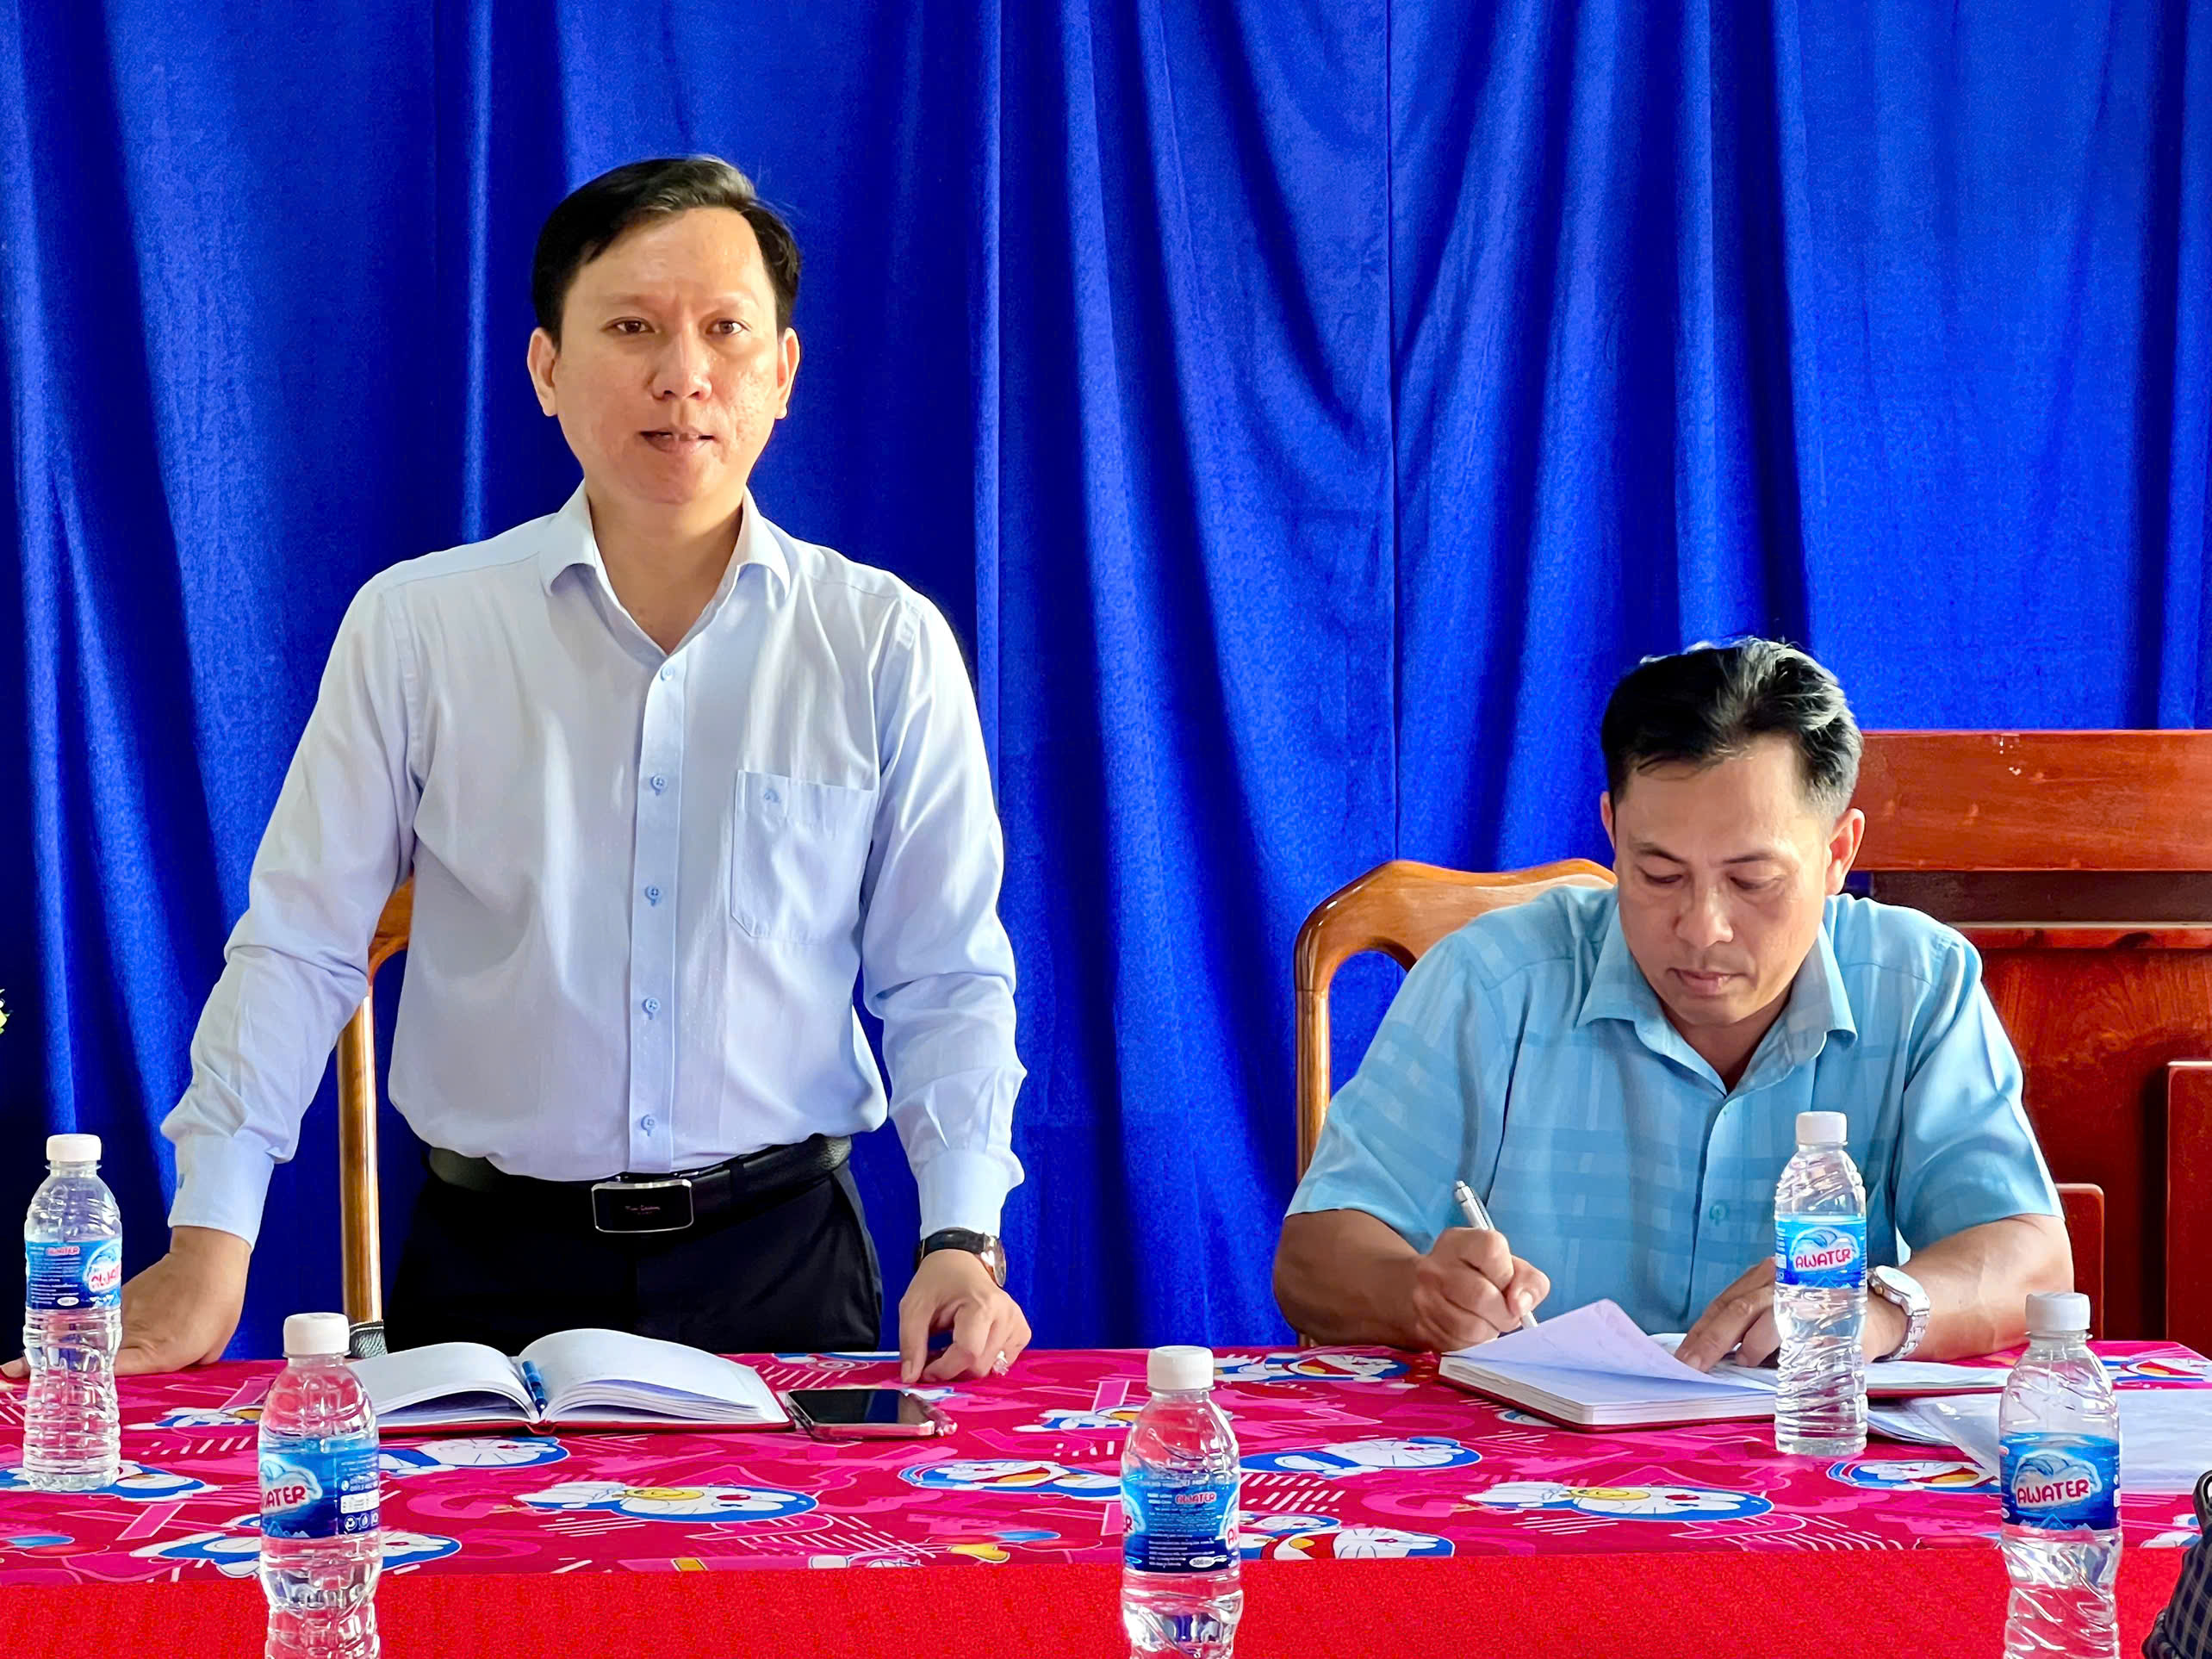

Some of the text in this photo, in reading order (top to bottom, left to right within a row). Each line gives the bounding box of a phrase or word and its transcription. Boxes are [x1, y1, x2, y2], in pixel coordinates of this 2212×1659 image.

[1795, 1249, 1850, 1269] AWATER
[1176, 1492, 1215, 1504] AWATER
[2016, 1479, 2089, 1504] AWATER
